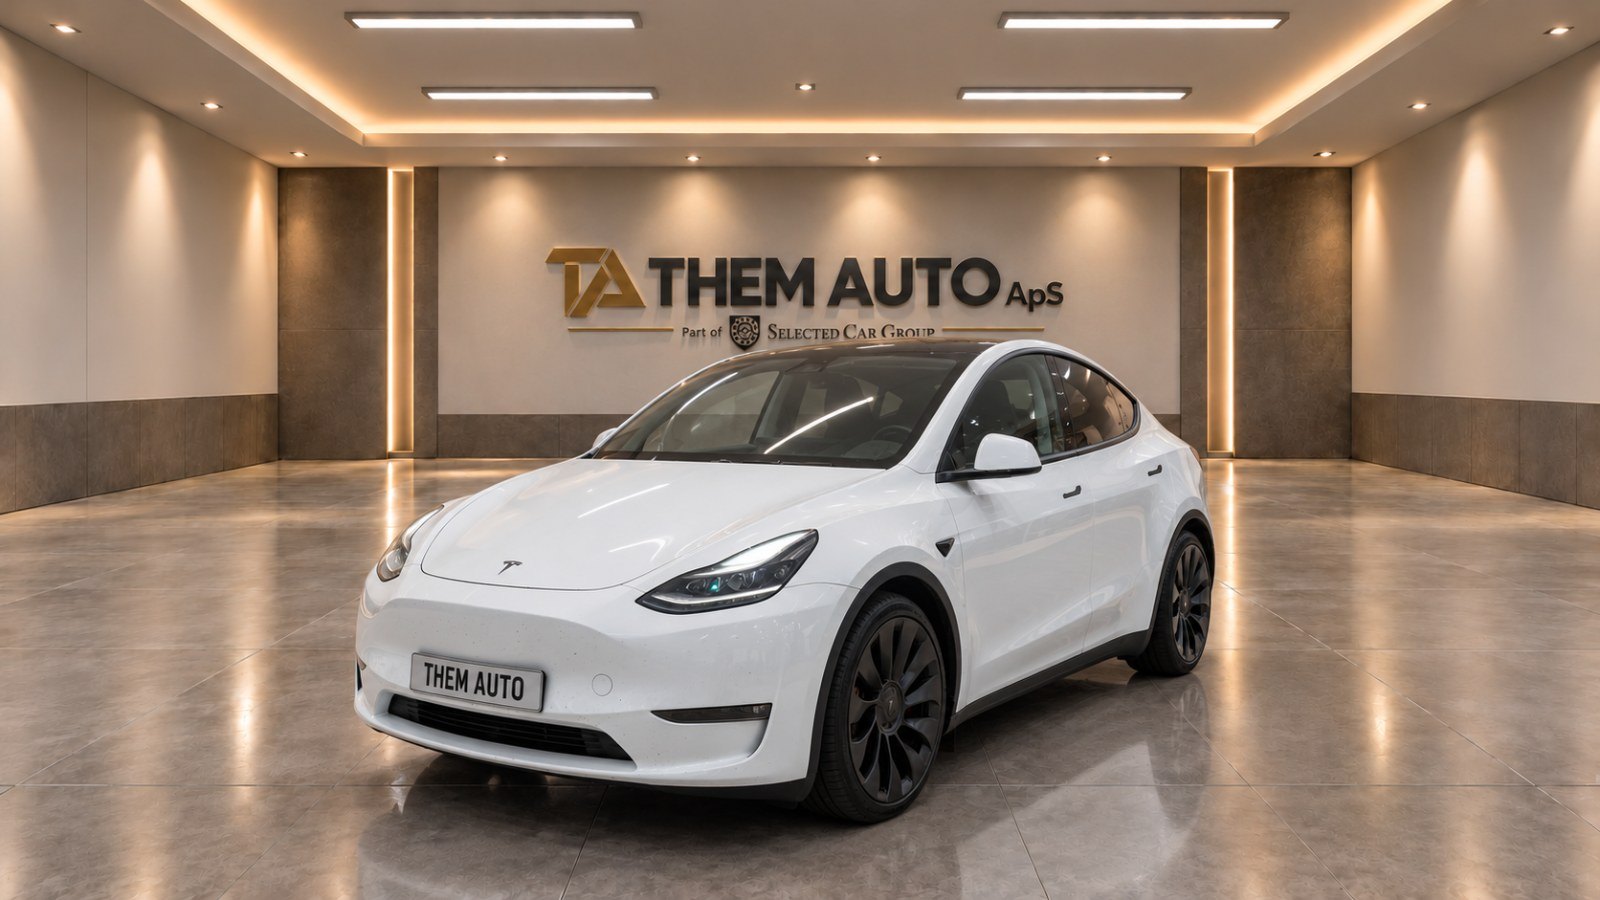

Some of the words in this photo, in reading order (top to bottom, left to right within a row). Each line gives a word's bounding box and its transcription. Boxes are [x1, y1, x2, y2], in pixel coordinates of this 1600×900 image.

[648, 257, 815, 307] THEM
[827, 257, 1001, 307] AUTO
[1004, 281, 1064, 312] ApS
[682, 327, 706, 337] Part
[709, 326, 722, 337] of
[767, 323, 840, 340] SELECTED
[843, 323, 877, 340] CAR
[424, 662, 469, 693] THEM
[473, 671, 524, 701] AUTO
